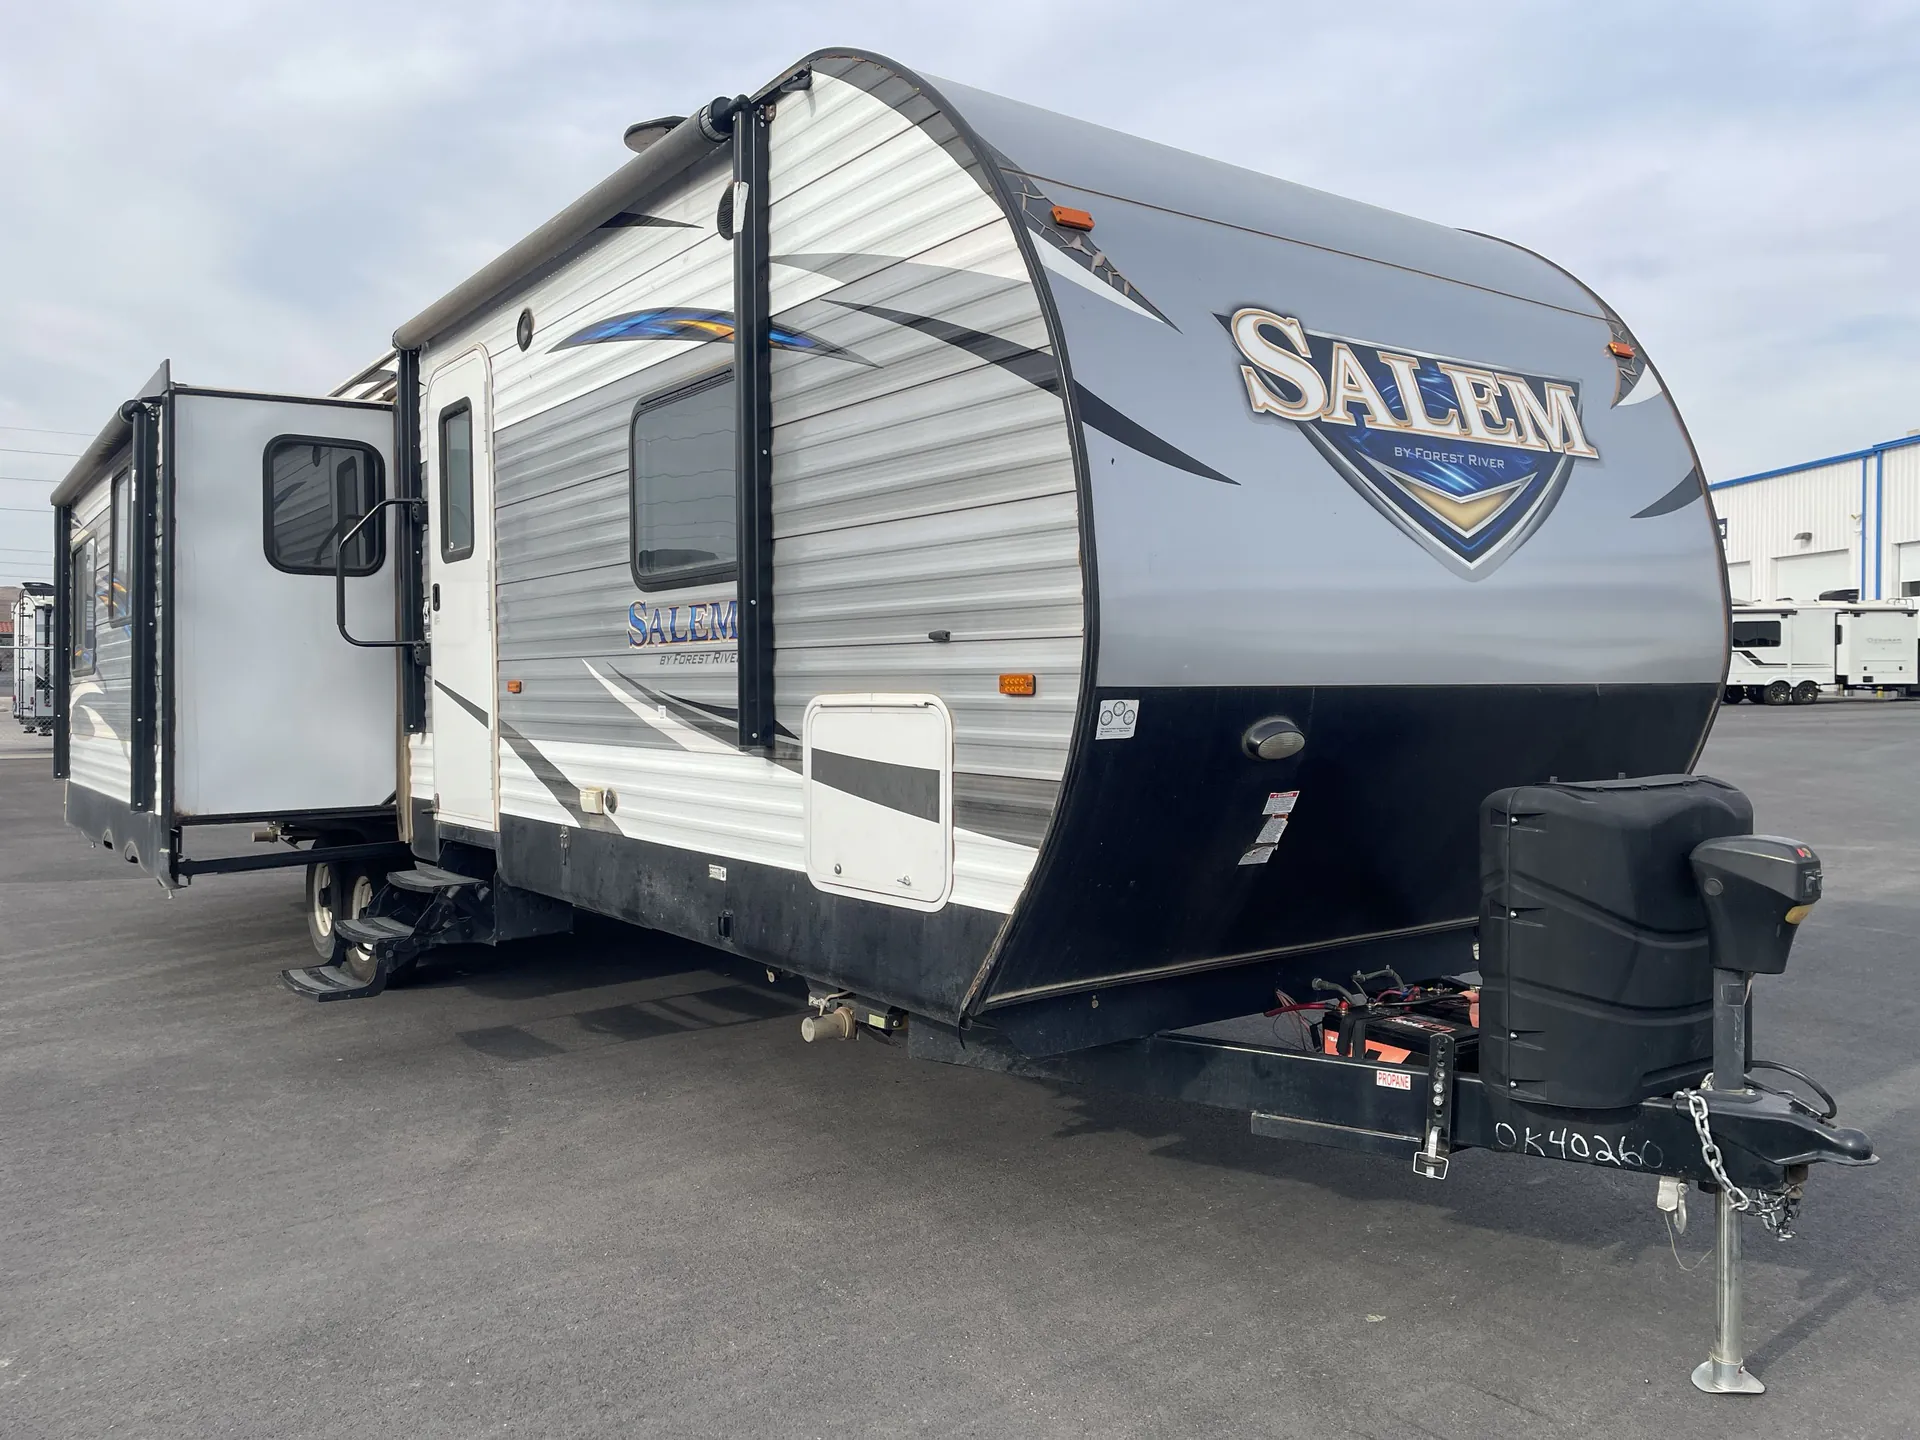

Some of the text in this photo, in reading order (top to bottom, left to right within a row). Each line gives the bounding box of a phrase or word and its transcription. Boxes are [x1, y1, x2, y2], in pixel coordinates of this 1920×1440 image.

[1230, 307, 1600, 460] SALEM
[627, 599, 738, 649] SALEM
[712, 651, 738, 664] RIVE
[1378, 1071, 1409, 1089] PROPANE
